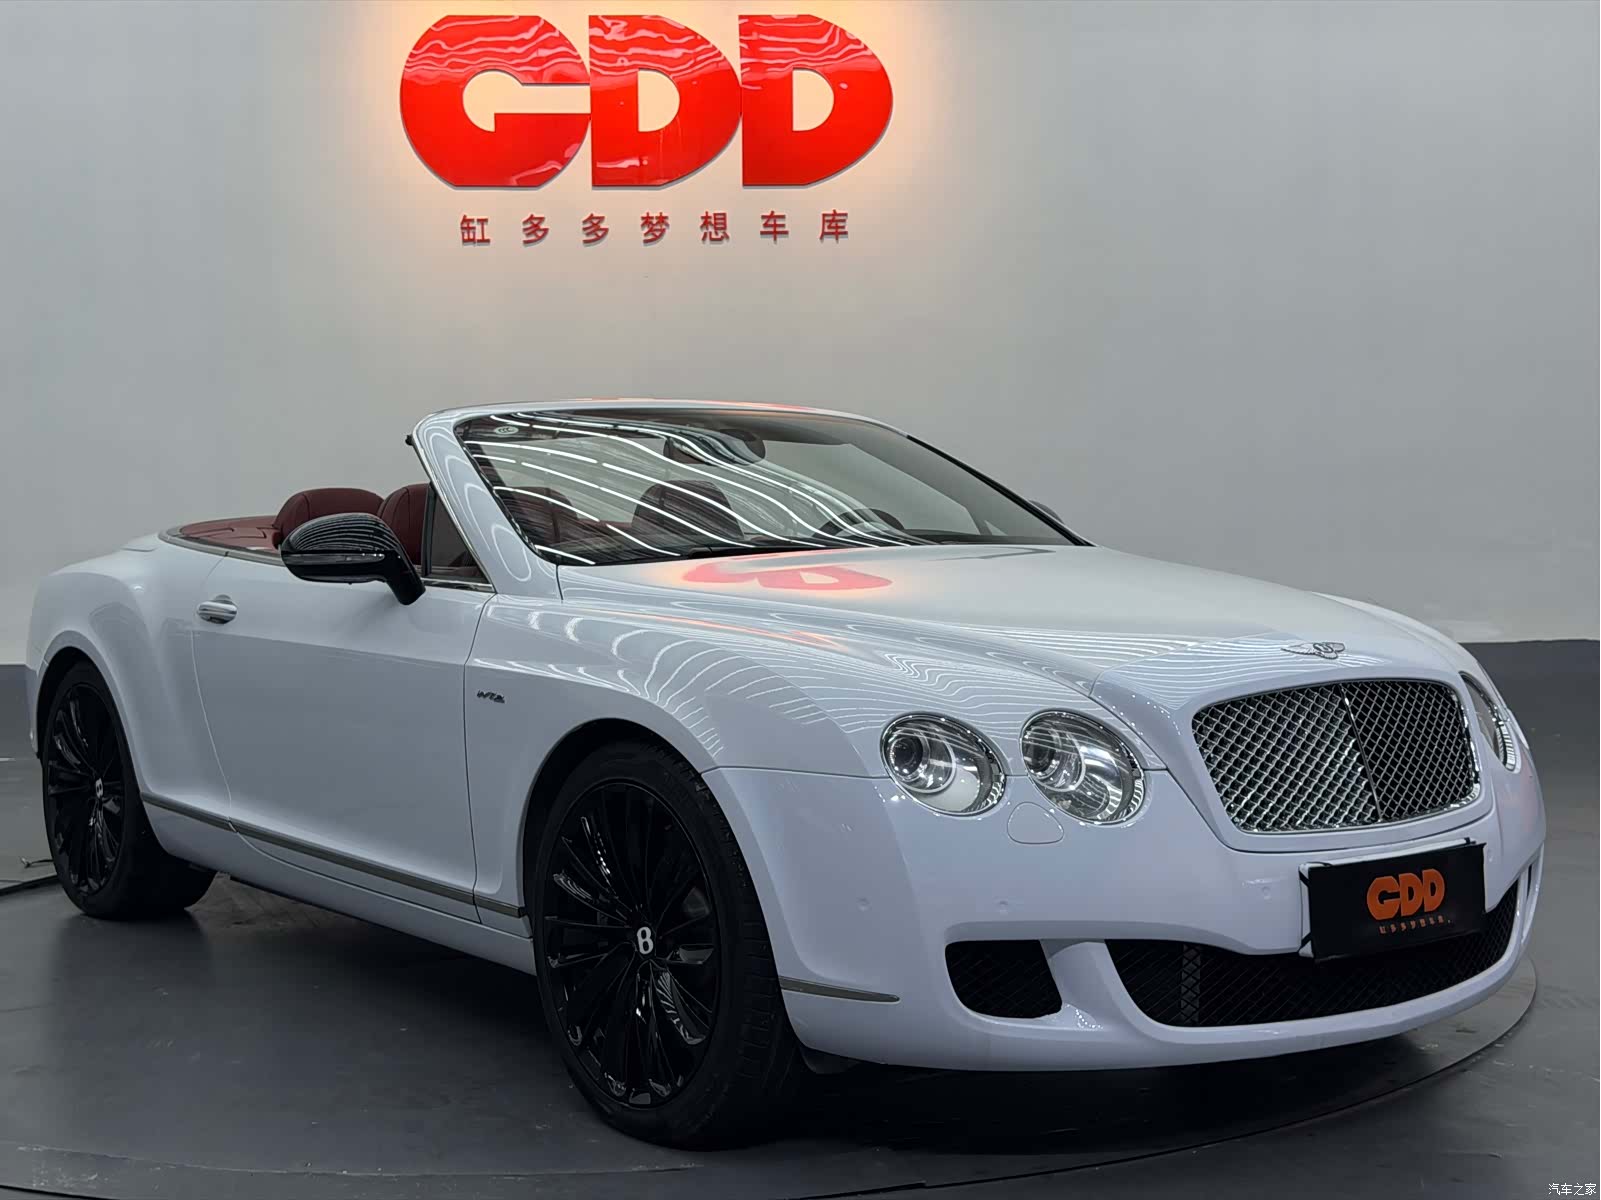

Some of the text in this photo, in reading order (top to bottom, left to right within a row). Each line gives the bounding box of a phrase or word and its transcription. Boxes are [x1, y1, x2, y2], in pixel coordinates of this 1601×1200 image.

[400, 15, 894, 188] GDD
[460, 209, 850, 244] 缸多多梦想车库
[1367, 868, 1446, 920] GDD
